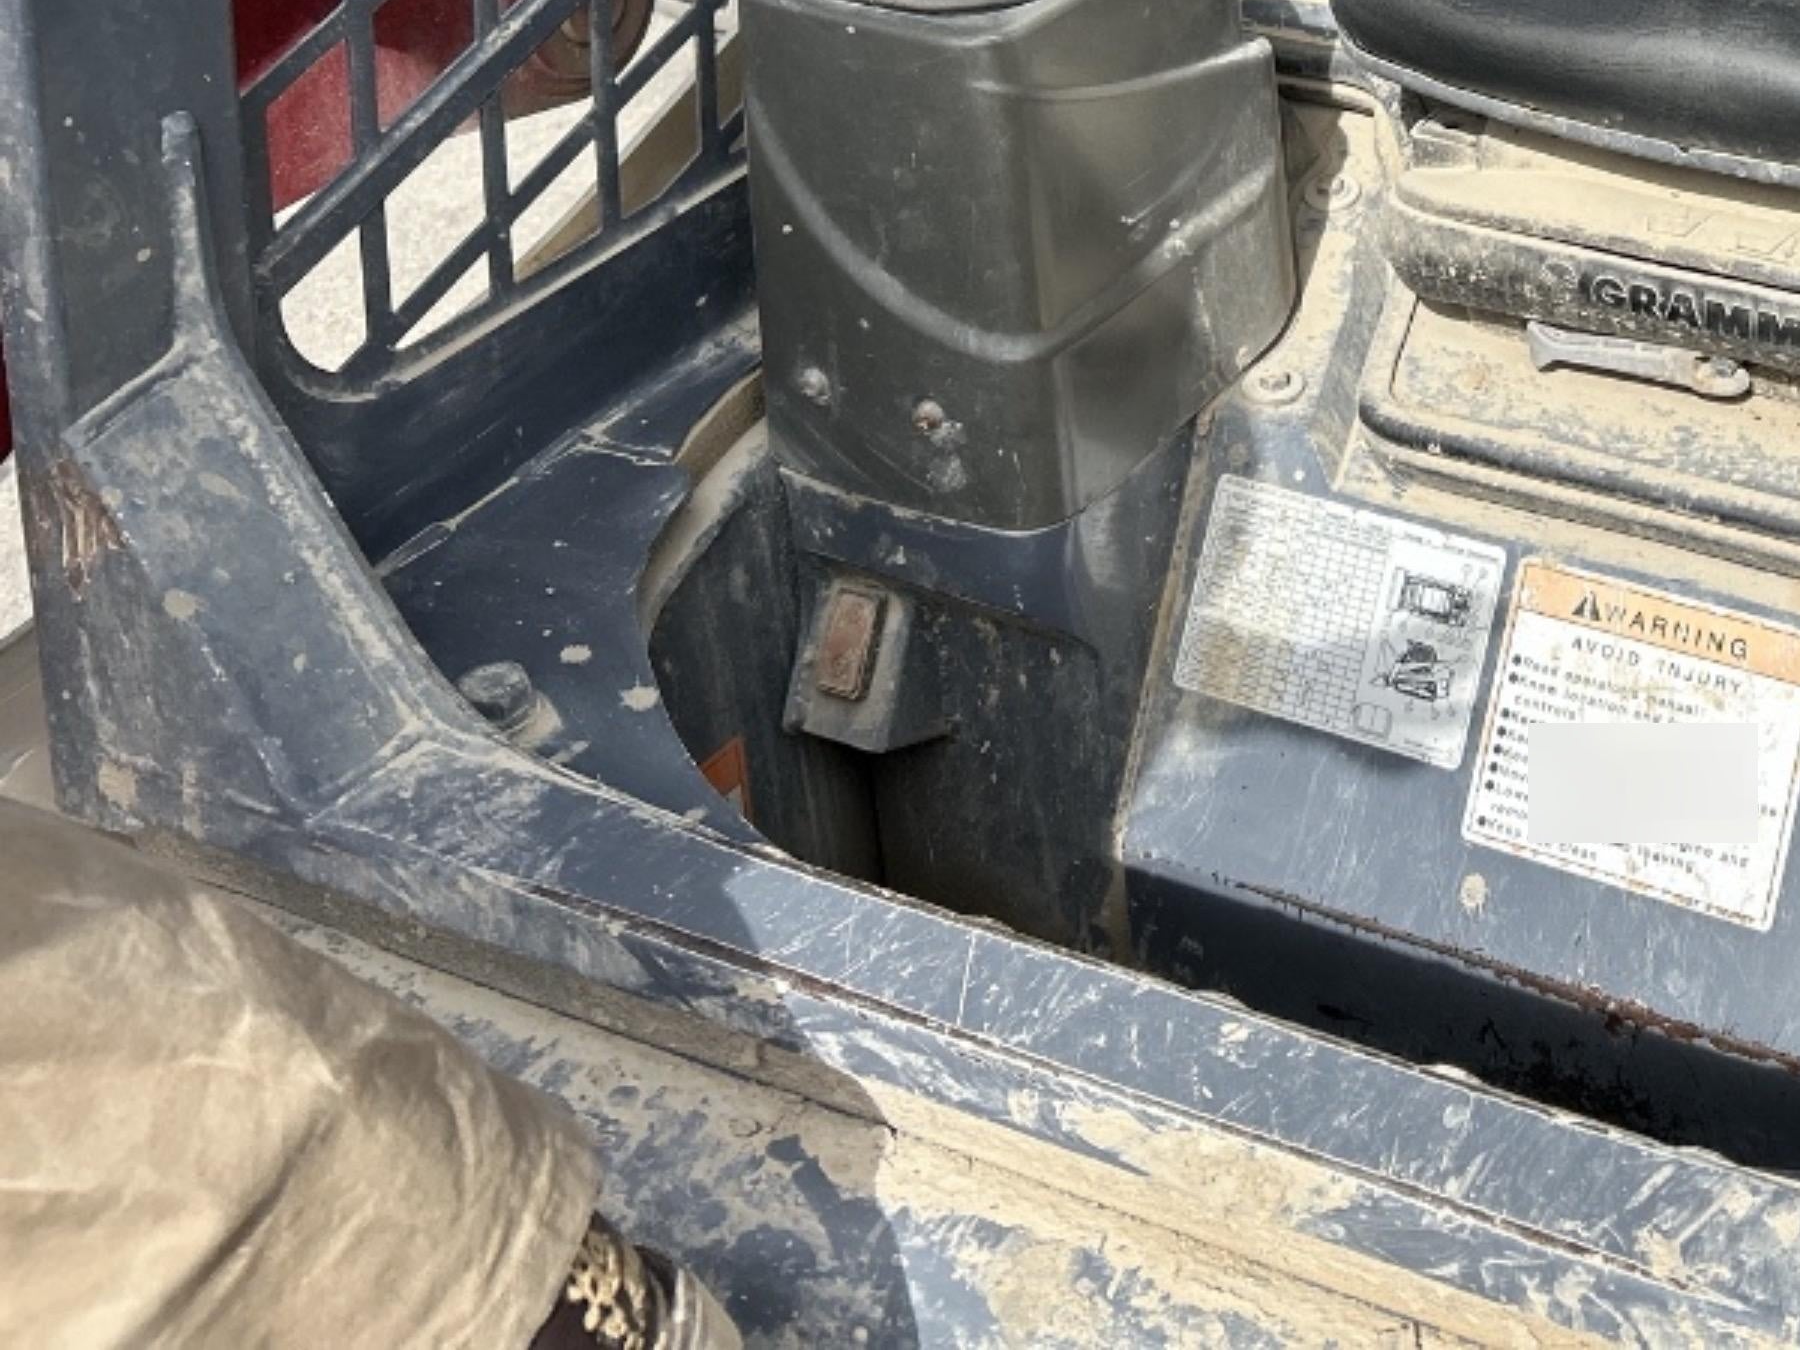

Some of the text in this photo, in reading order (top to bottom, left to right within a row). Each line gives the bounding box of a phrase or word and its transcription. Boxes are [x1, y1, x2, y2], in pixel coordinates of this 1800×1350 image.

[1604, 603, 1749, 662] WARNING
[1571, 636, 1743, 694] AVOID INJURY
